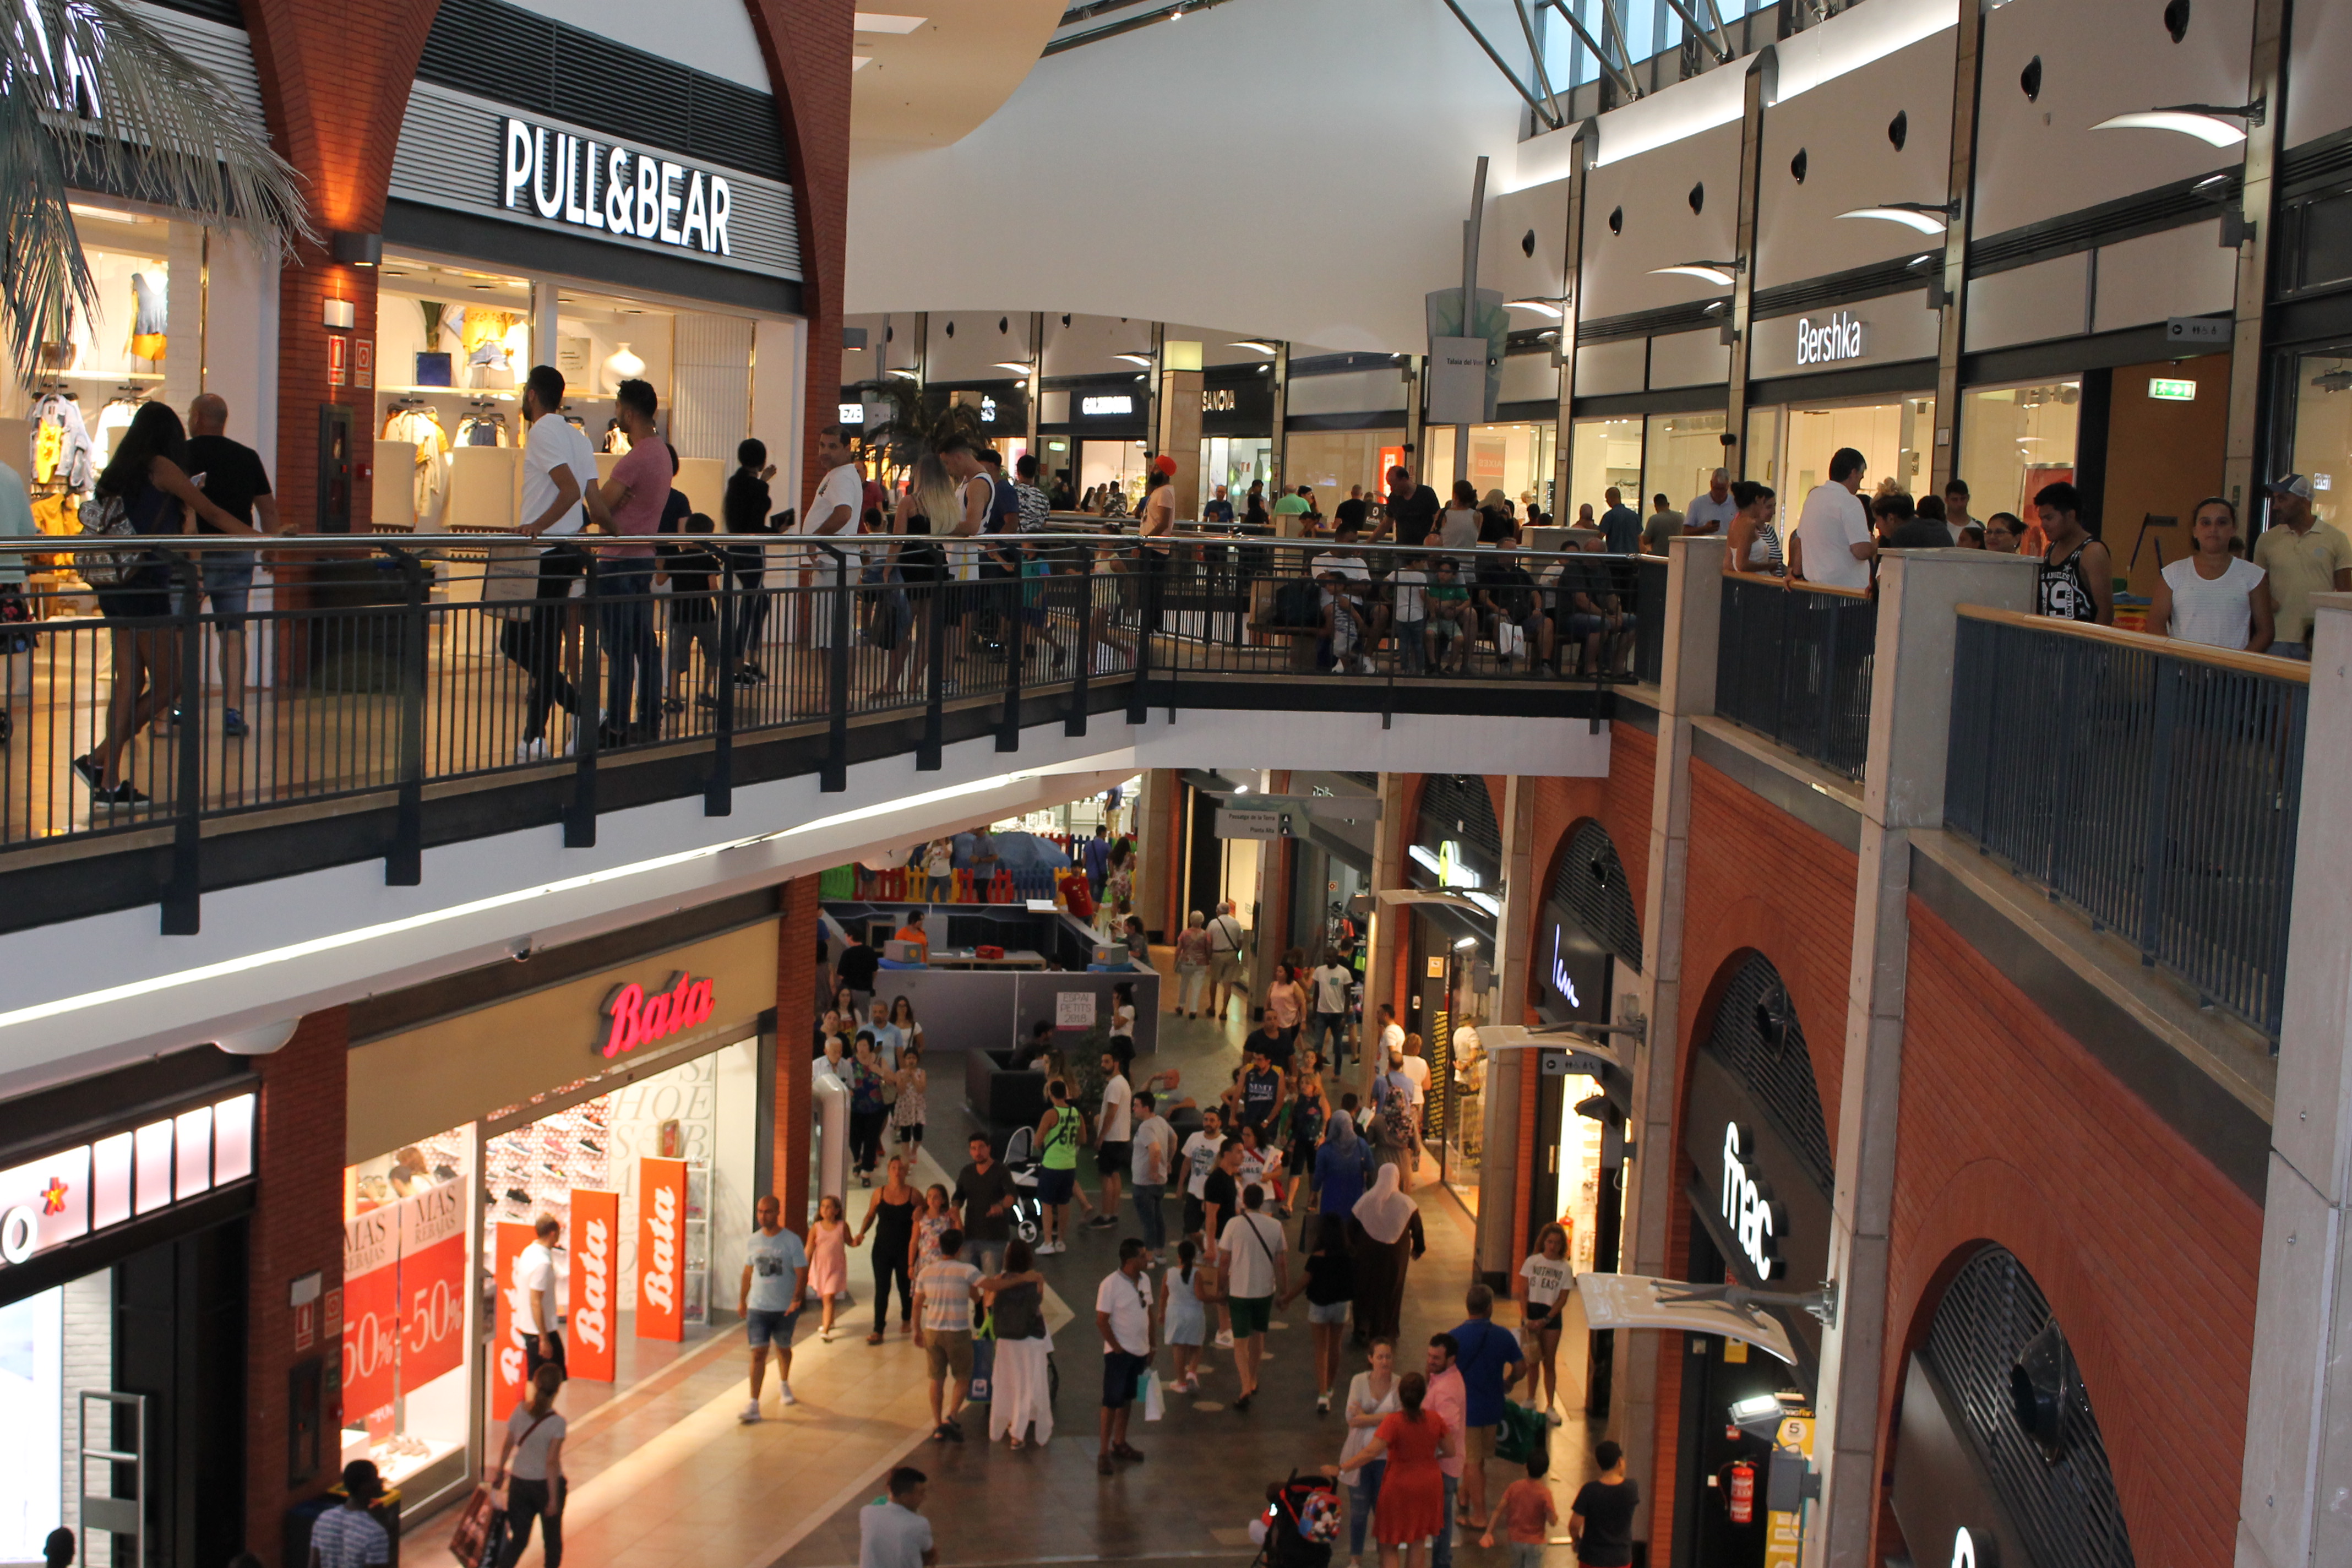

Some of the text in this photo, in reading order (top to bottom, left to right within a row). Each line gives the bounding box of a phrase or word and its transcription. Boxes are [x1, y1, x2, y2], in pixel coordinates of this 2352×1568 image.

[505, 118, 731, 255] PULL&BEAR
[1797, 311, 1860, 365] Bershka
[2046, 571, 2071, 581] ANGELES
[603, 971, 715, 1059] Bata
[1060, 1003, 1091, 1012] PETITS
[1063, 993, 1088, 1001] ESPAI
[415, 1184, 456, 1227] MAS
[1722, 1121, 1773, 1281] fnac
[415, 1218, 456, 1245] REBAJAS
[644, 1185, 676, 1315] Bata
[575, 1218, 608, 1354] Bata
[1533, 1265, 1563, 1281] NOTHING
[402, 1279, 463, 1353] -50%
[1789, 1422, 1800, 1434] 5
